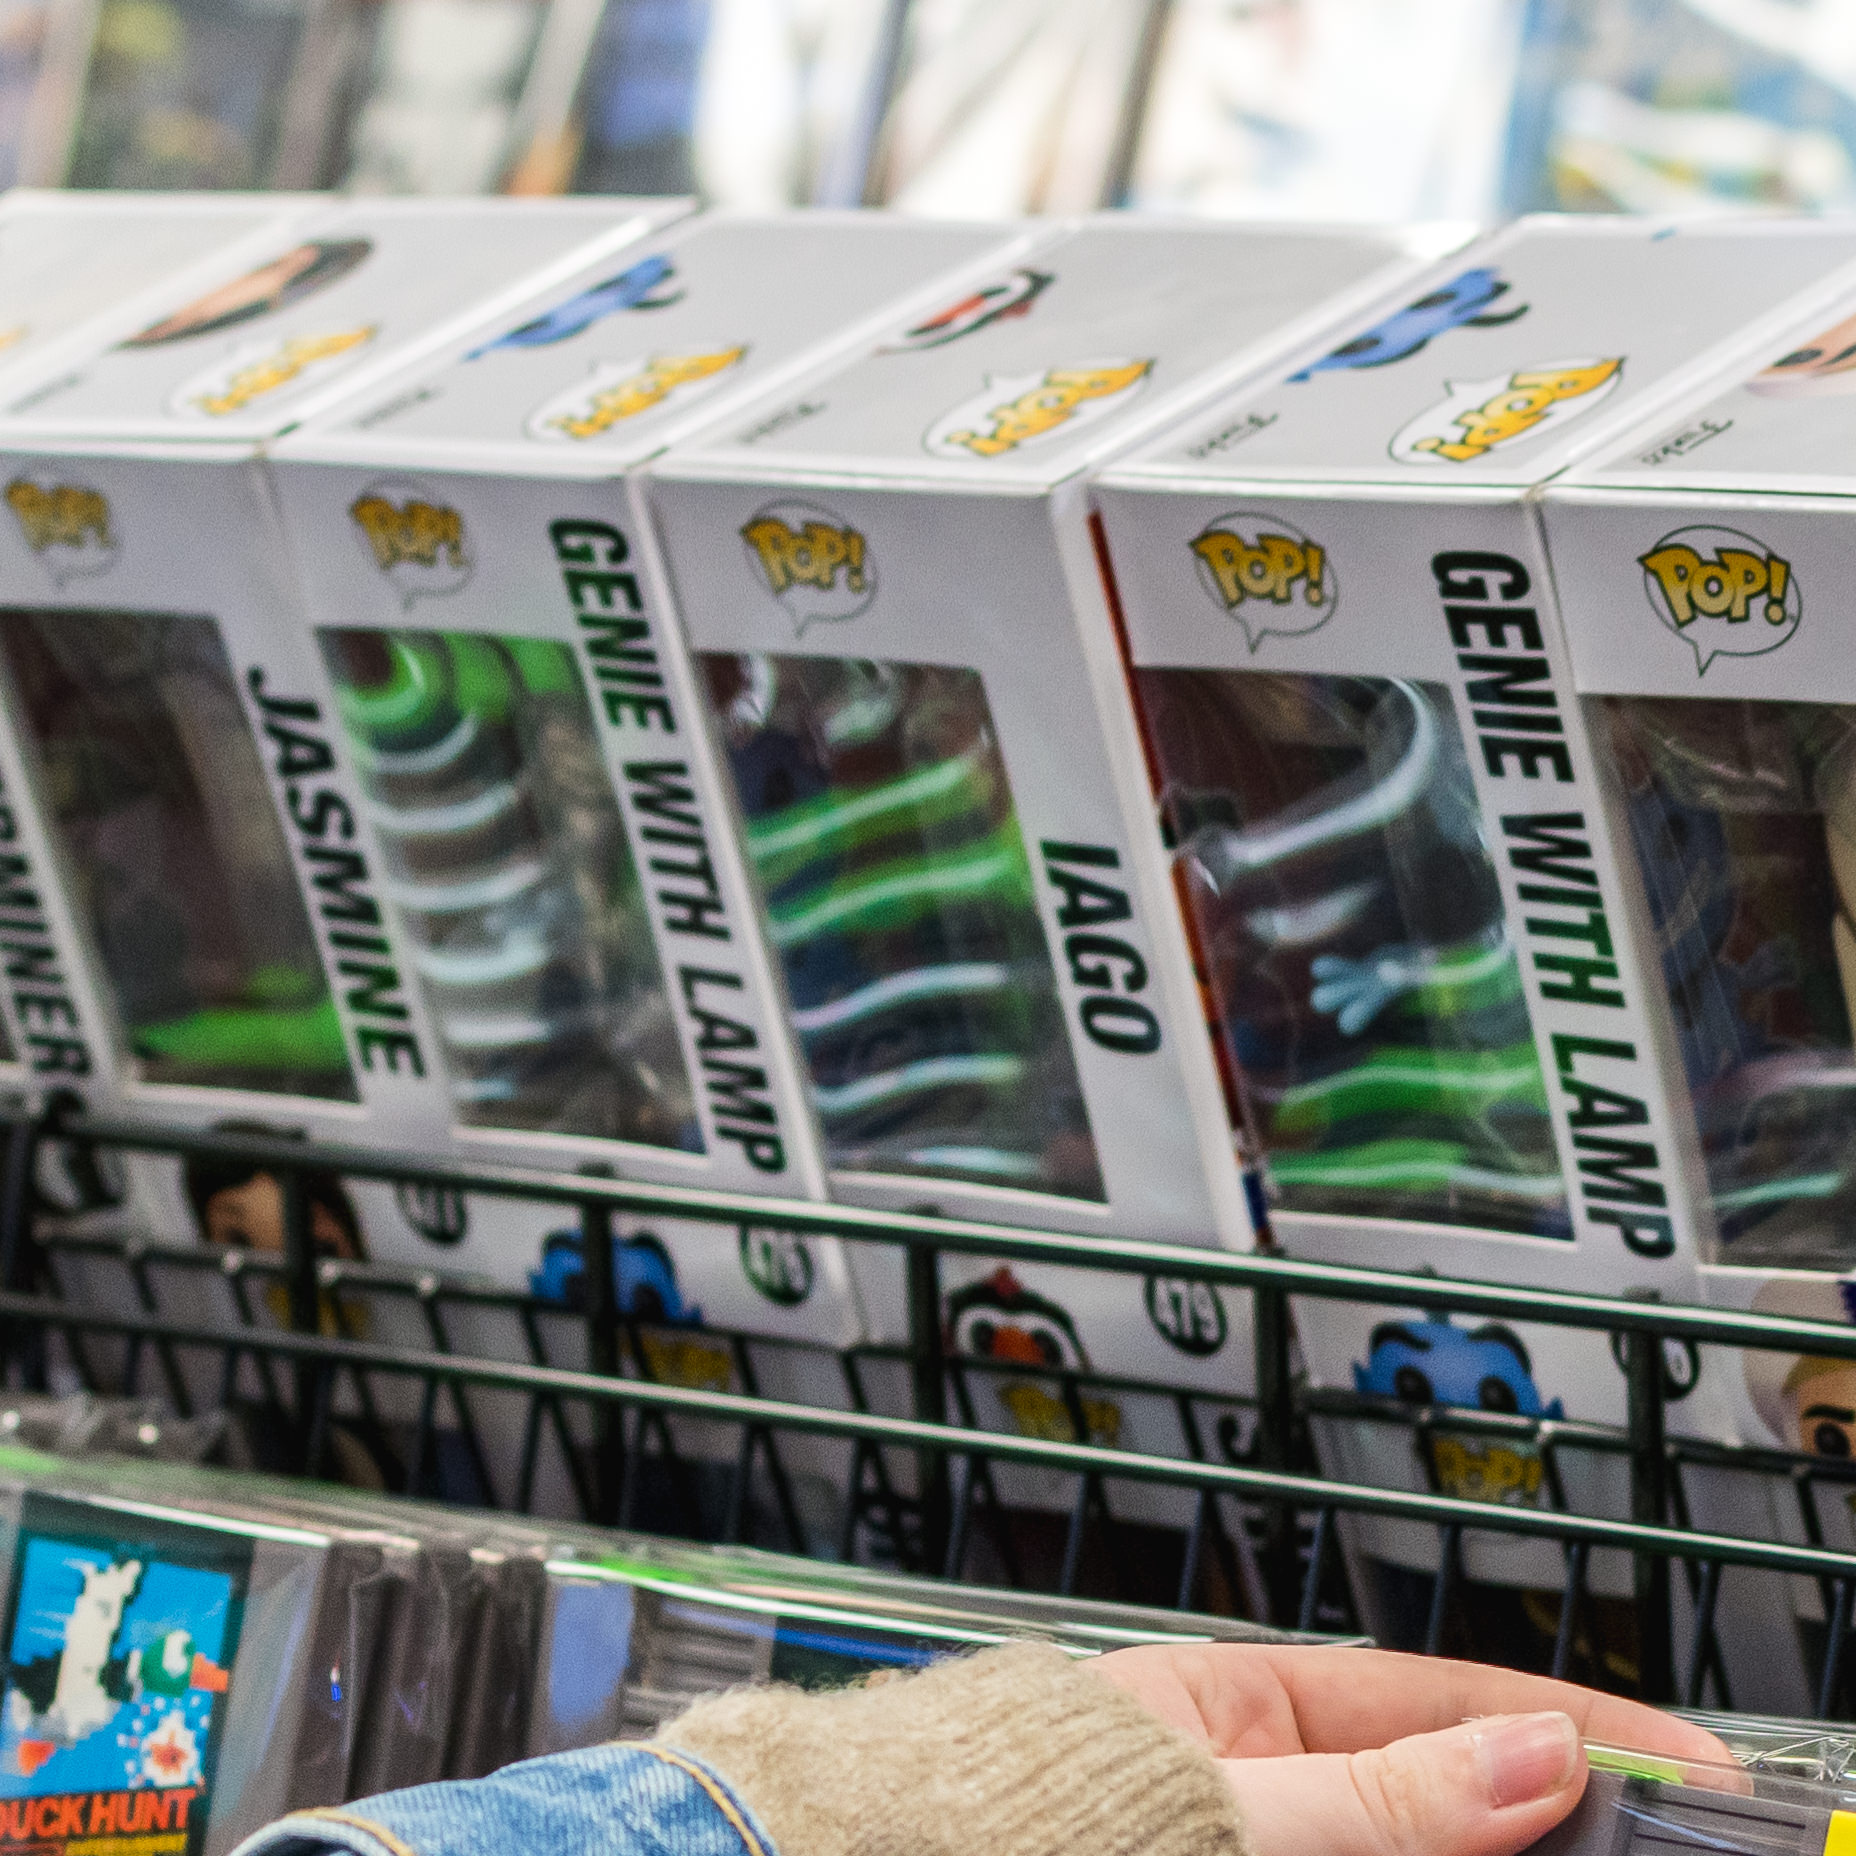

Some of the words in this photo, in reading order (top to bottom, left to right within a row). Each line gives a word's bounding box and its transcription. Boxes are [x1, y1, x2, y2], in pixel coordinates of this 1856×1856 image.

[1413, 357, 1627, 462] POP!
[739, 519, 868, 595] POP!
[1188, 531, 1324, 603] POP!
[1638, 543, 1790, 628] POP!
[1432, 550, 1575, 784] GENIE
[246, 667, 427, 1079] JASMINE
[547, 518, 677, 736] GENIE
[622, 760, 734, 942] WITH
[678, 963, 785, 1175] LAMP
[1499, 811, 1626, 1009] WITH
[1040, 839, 1163, 1055] IAGO
[1550, 1031, 1676, 1260] LAMP
[89, 1788, 197, 1834] HUNT
